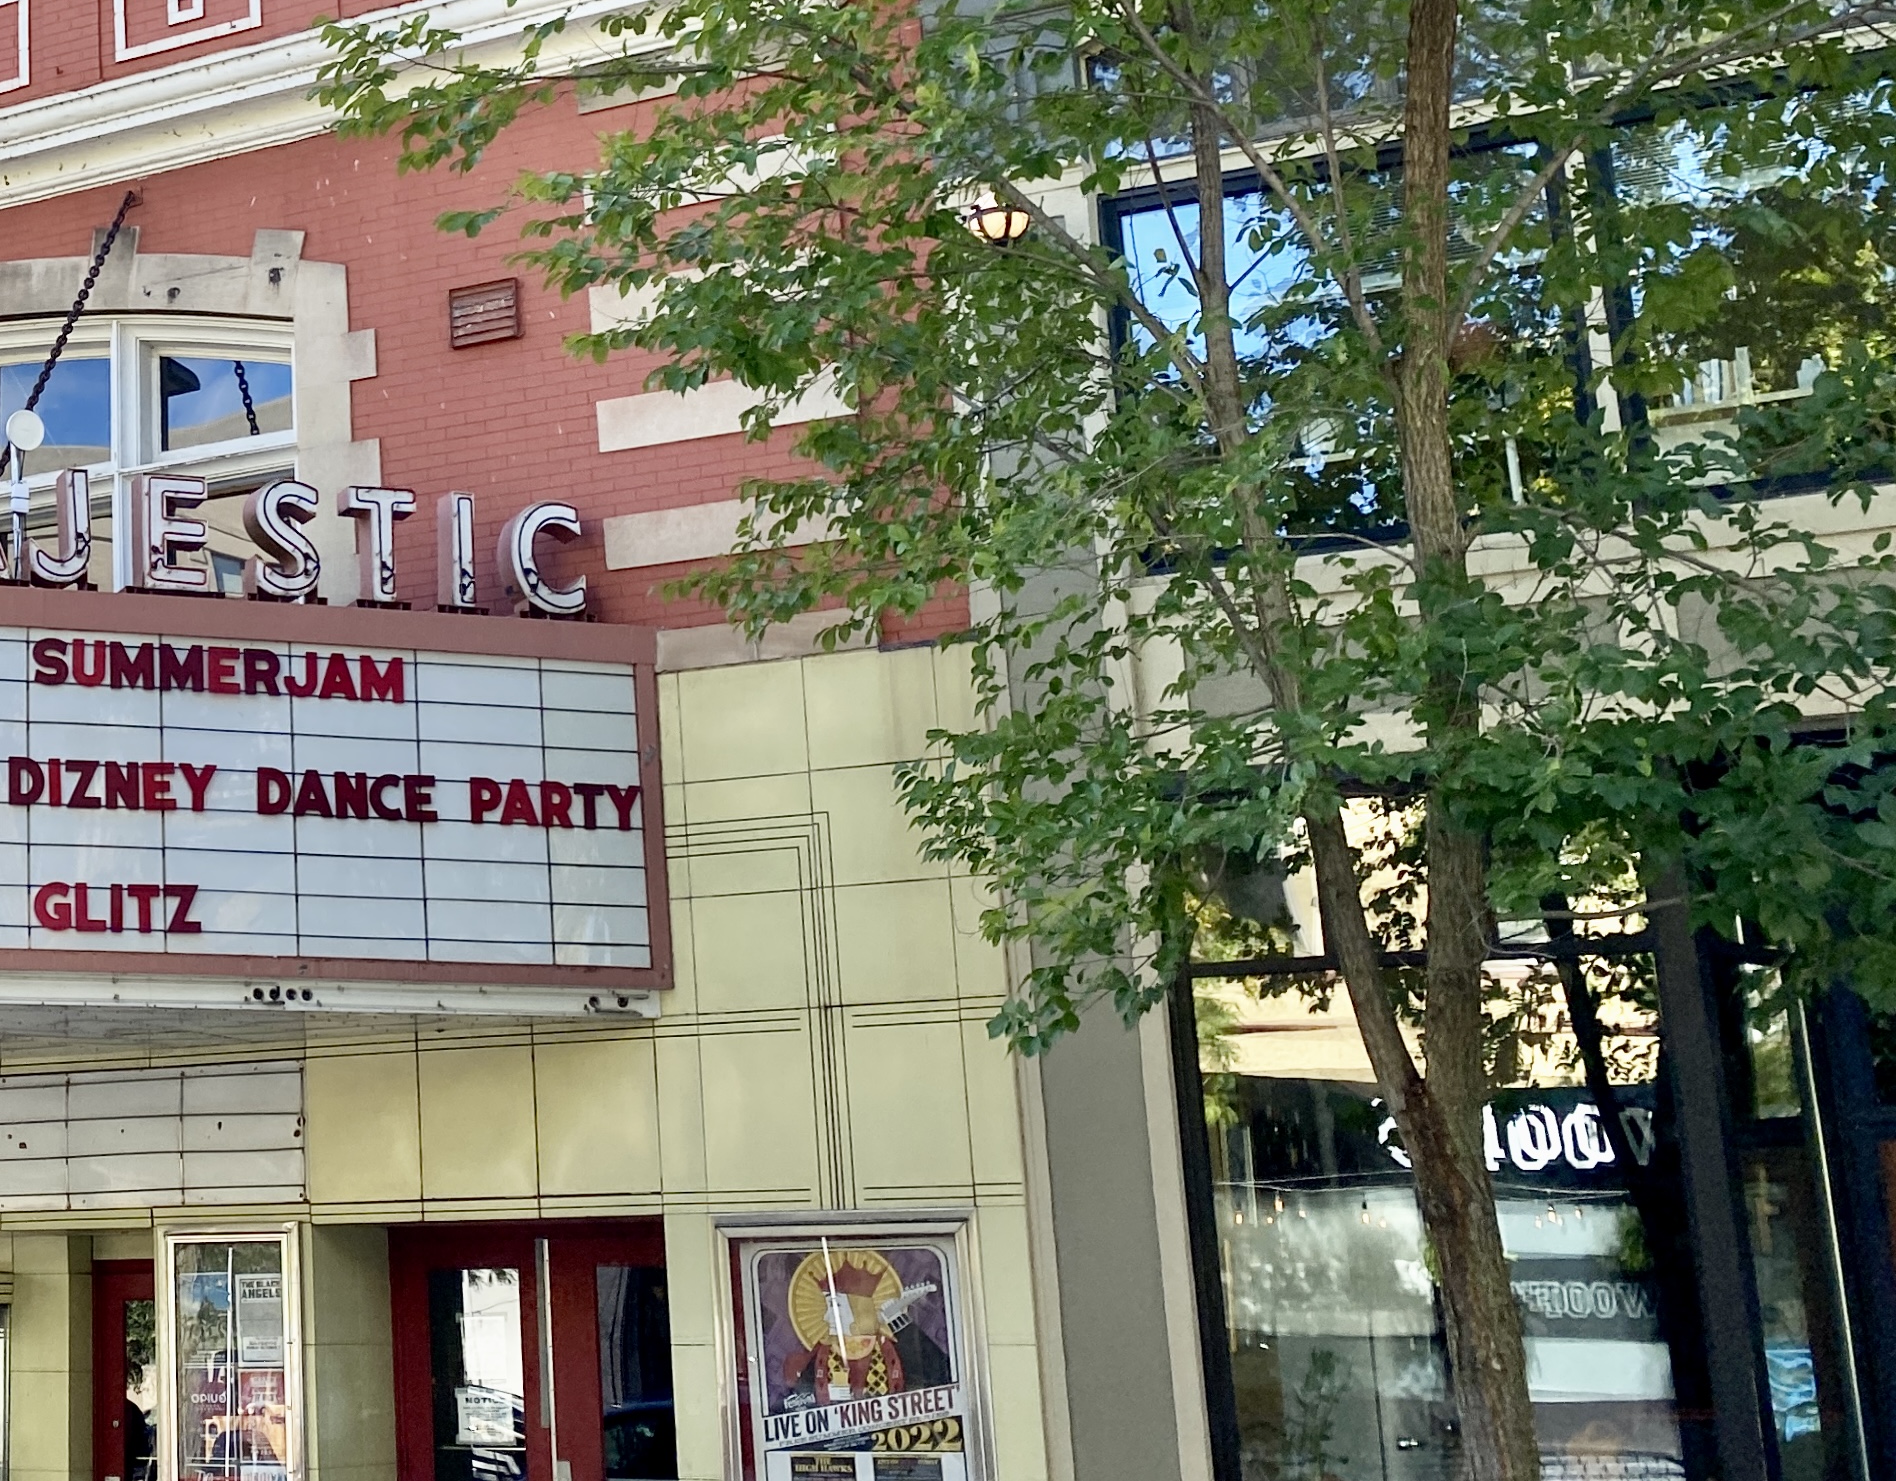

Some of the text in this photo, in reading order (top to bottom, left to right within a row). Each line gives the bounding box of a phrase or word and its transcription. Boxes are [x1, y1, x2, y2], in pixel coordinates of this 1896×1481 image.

[32, 637, 405, 704] SUMMERJAM
[8, 756, 217, 812] DIZNEY
[257, 768, 439, 823] DANCE
[470, 777, 642, 832] PARTY
[33, 881, 202, 934] GLITZ
[241, 1288, 282, 1299] ANGELS
[764, 1414, 802, 1443] LIVE
[806, 1409, 829, 1434] ON
[871, 1418, 964, 1452] 2022
